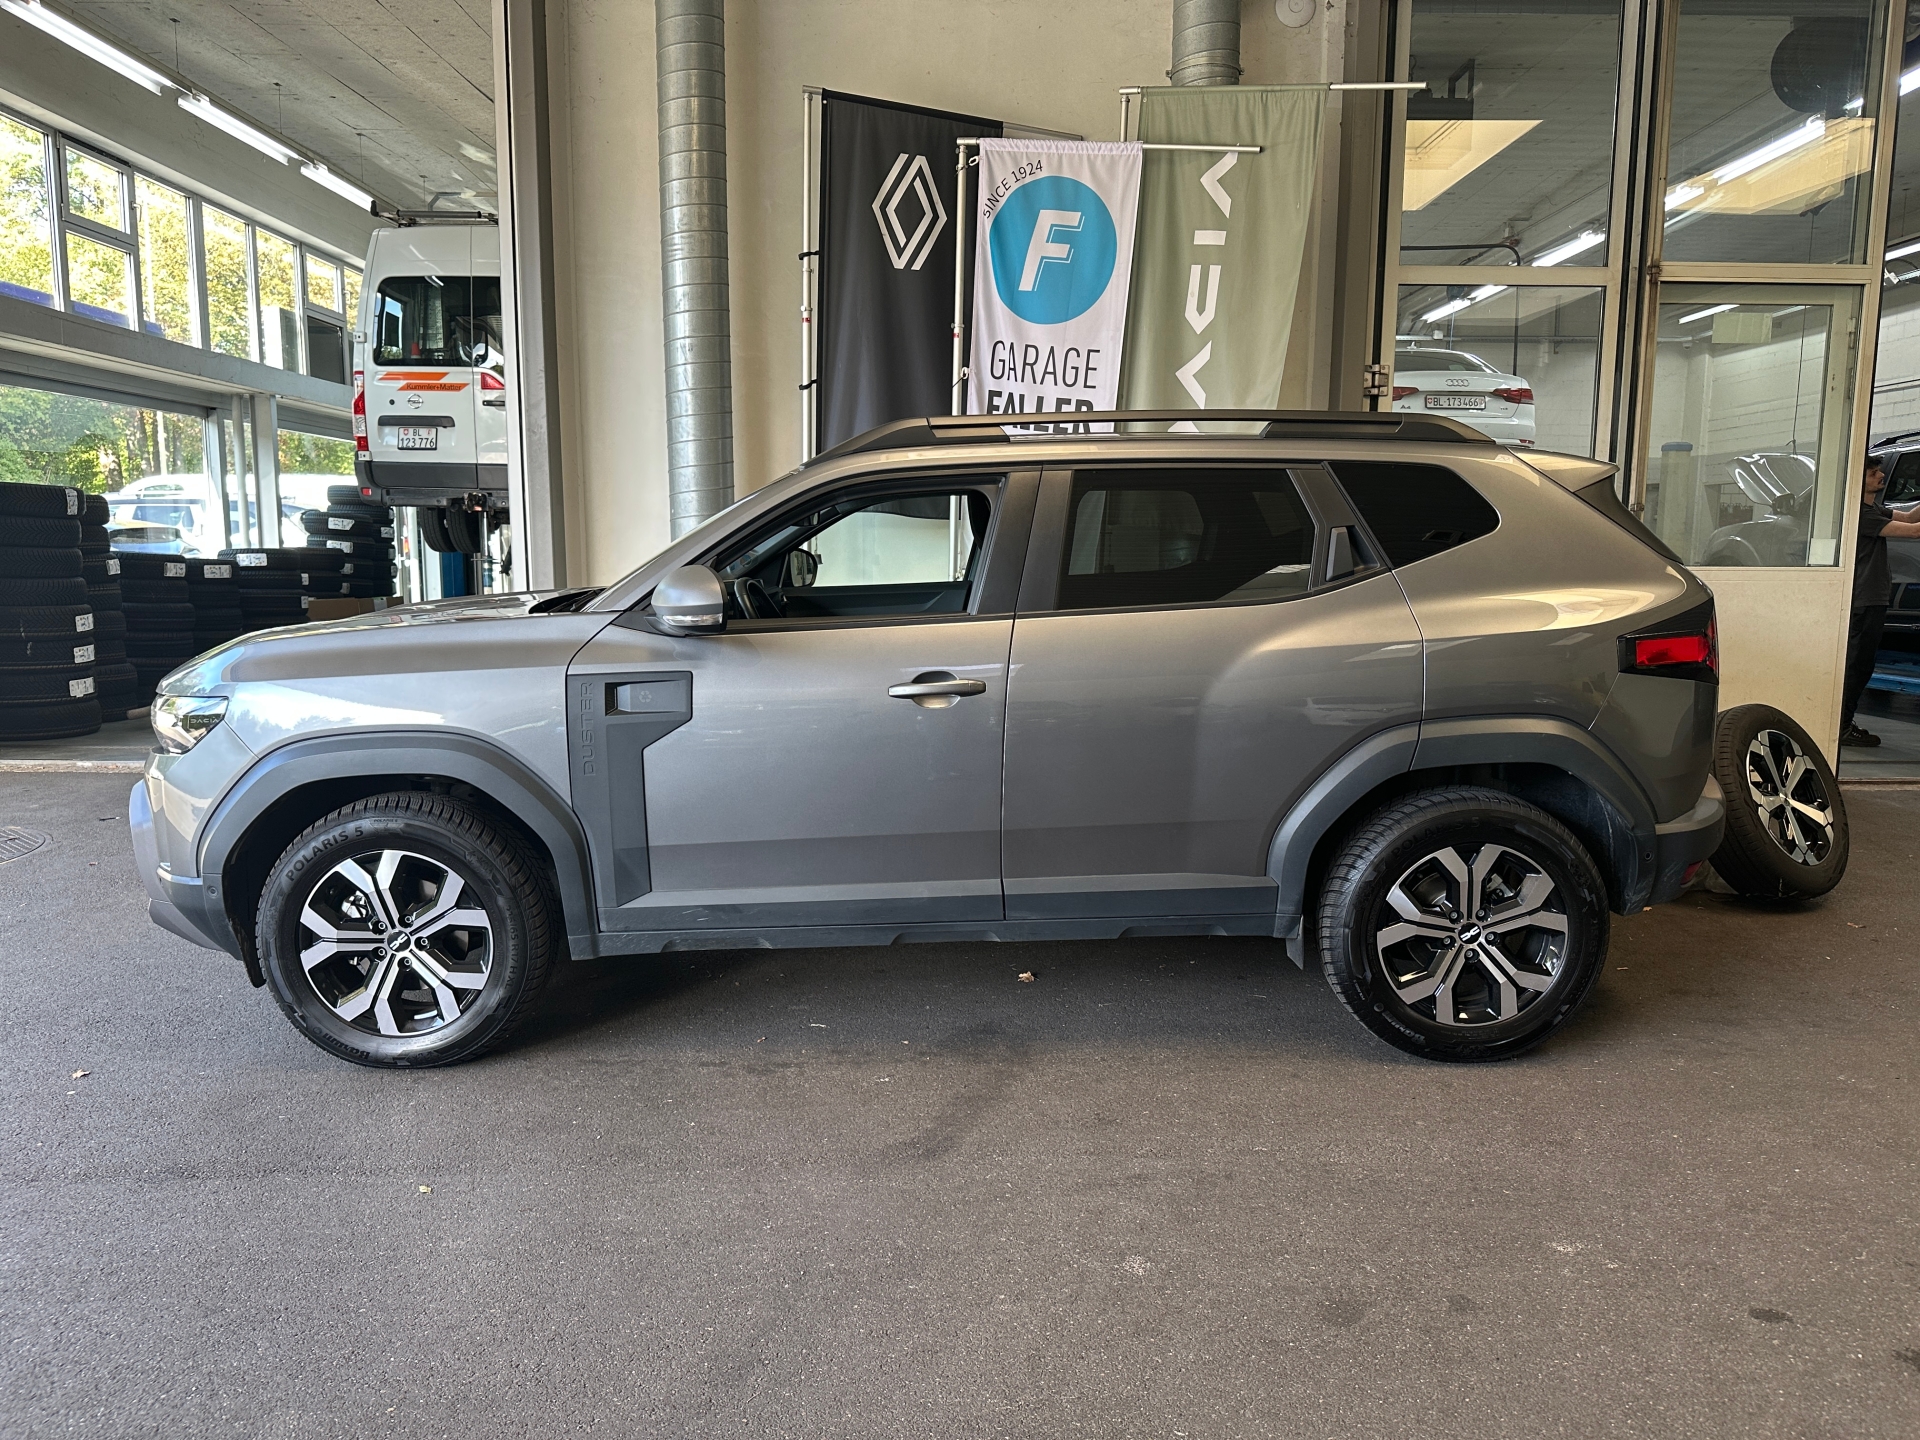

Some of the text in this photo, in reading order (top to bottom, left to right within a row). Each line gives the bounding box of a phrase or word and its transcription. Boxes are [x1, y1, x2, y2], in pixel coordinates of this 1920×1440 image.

[983, 159, 1044, 219] SINCE 1924
[1168, 144, 1239, 432] ACIA
[990, 340, 1101, 389] GARAGE
[413, 428, 422, 437] BL
[580, 682, 596, 776] DUSTER
[285, 826, 364, 882] POLARIS 5
